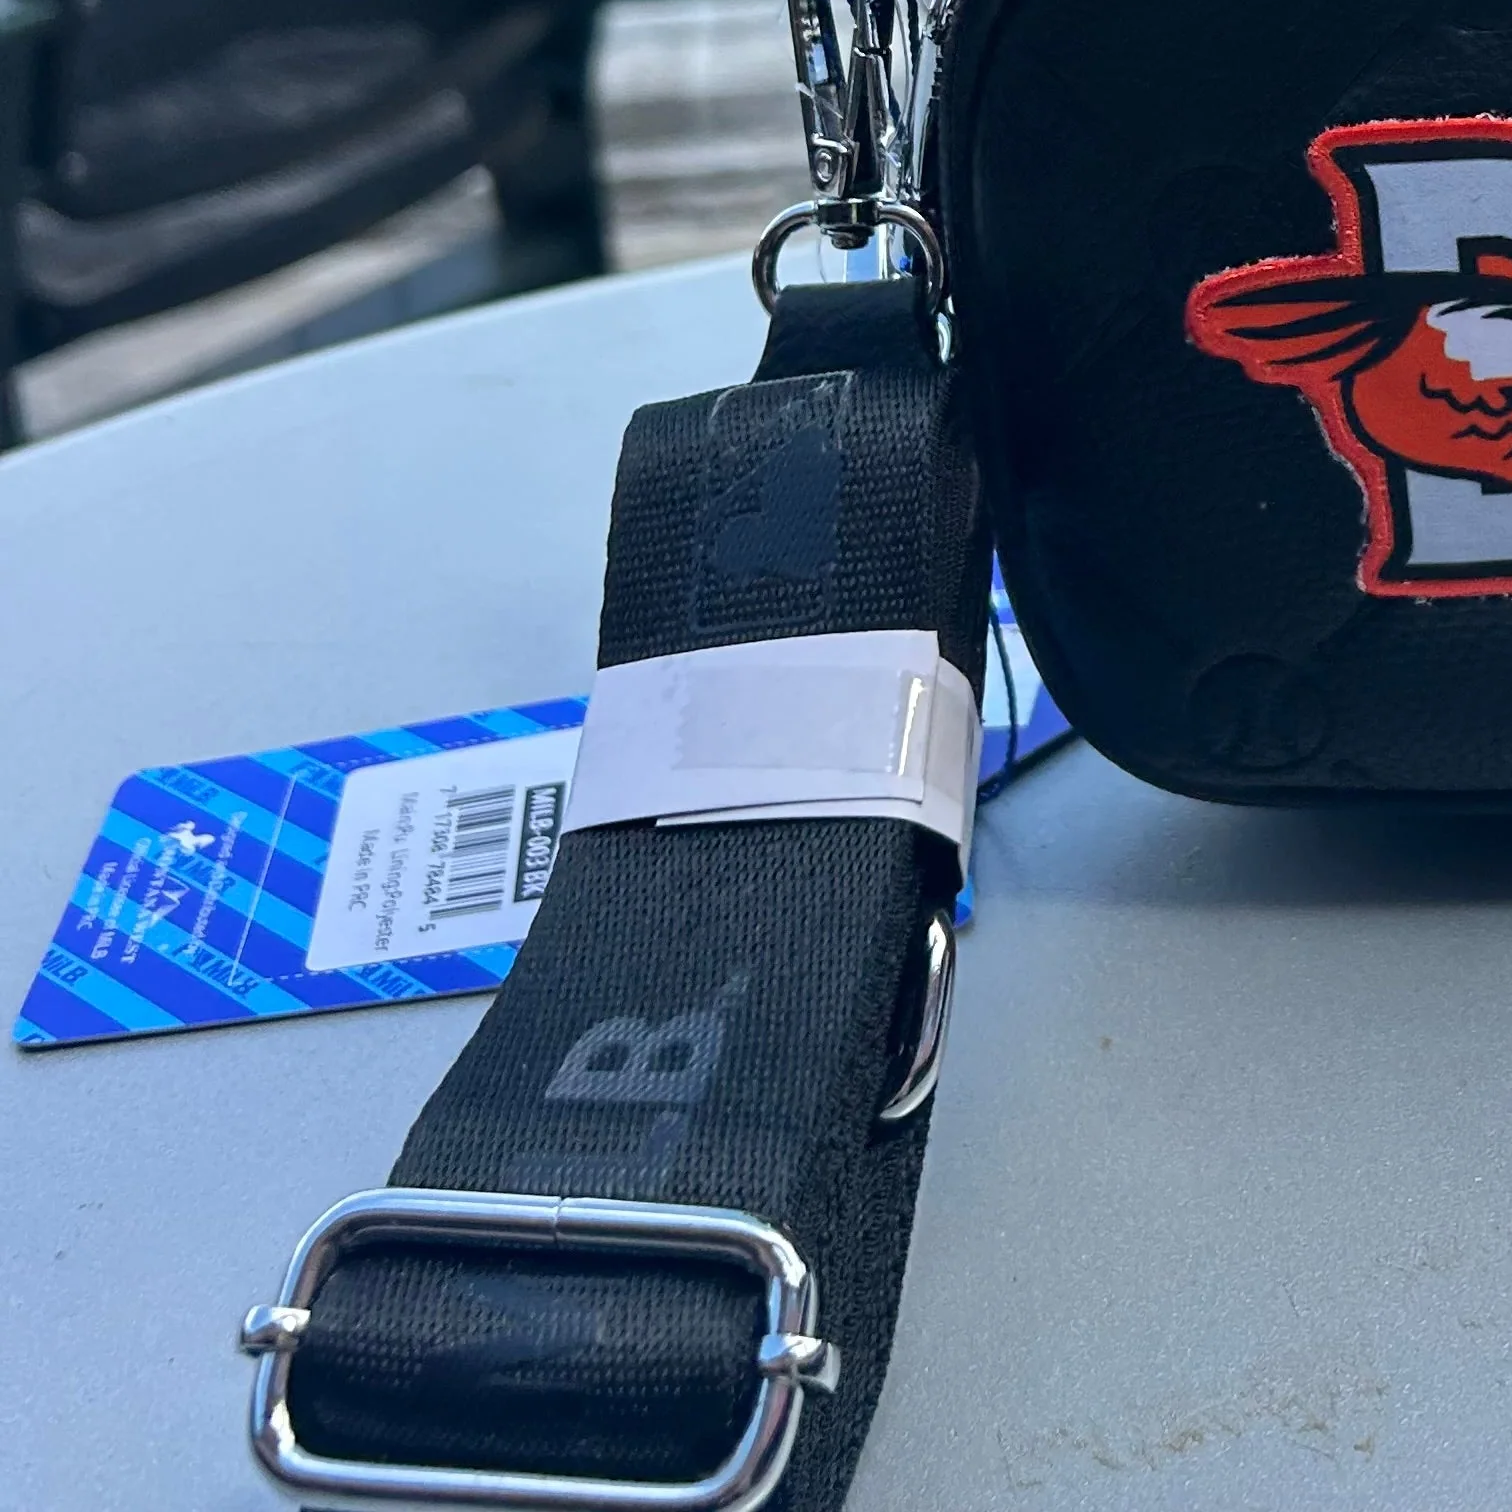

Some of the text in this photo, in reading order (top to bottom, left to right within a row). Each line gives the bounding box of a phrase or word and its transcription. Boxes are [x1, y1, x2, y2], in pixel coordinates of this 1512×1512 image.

[429, 811, 453, 853] 17308
[524, 787, 557, 868] MILB-003
[348, 828, 381, 912] Made in PRC
[422, 862, 445, 904] 78484
[120, 921, 150, 965] WEST
[416, 922, 437, 933] 5
